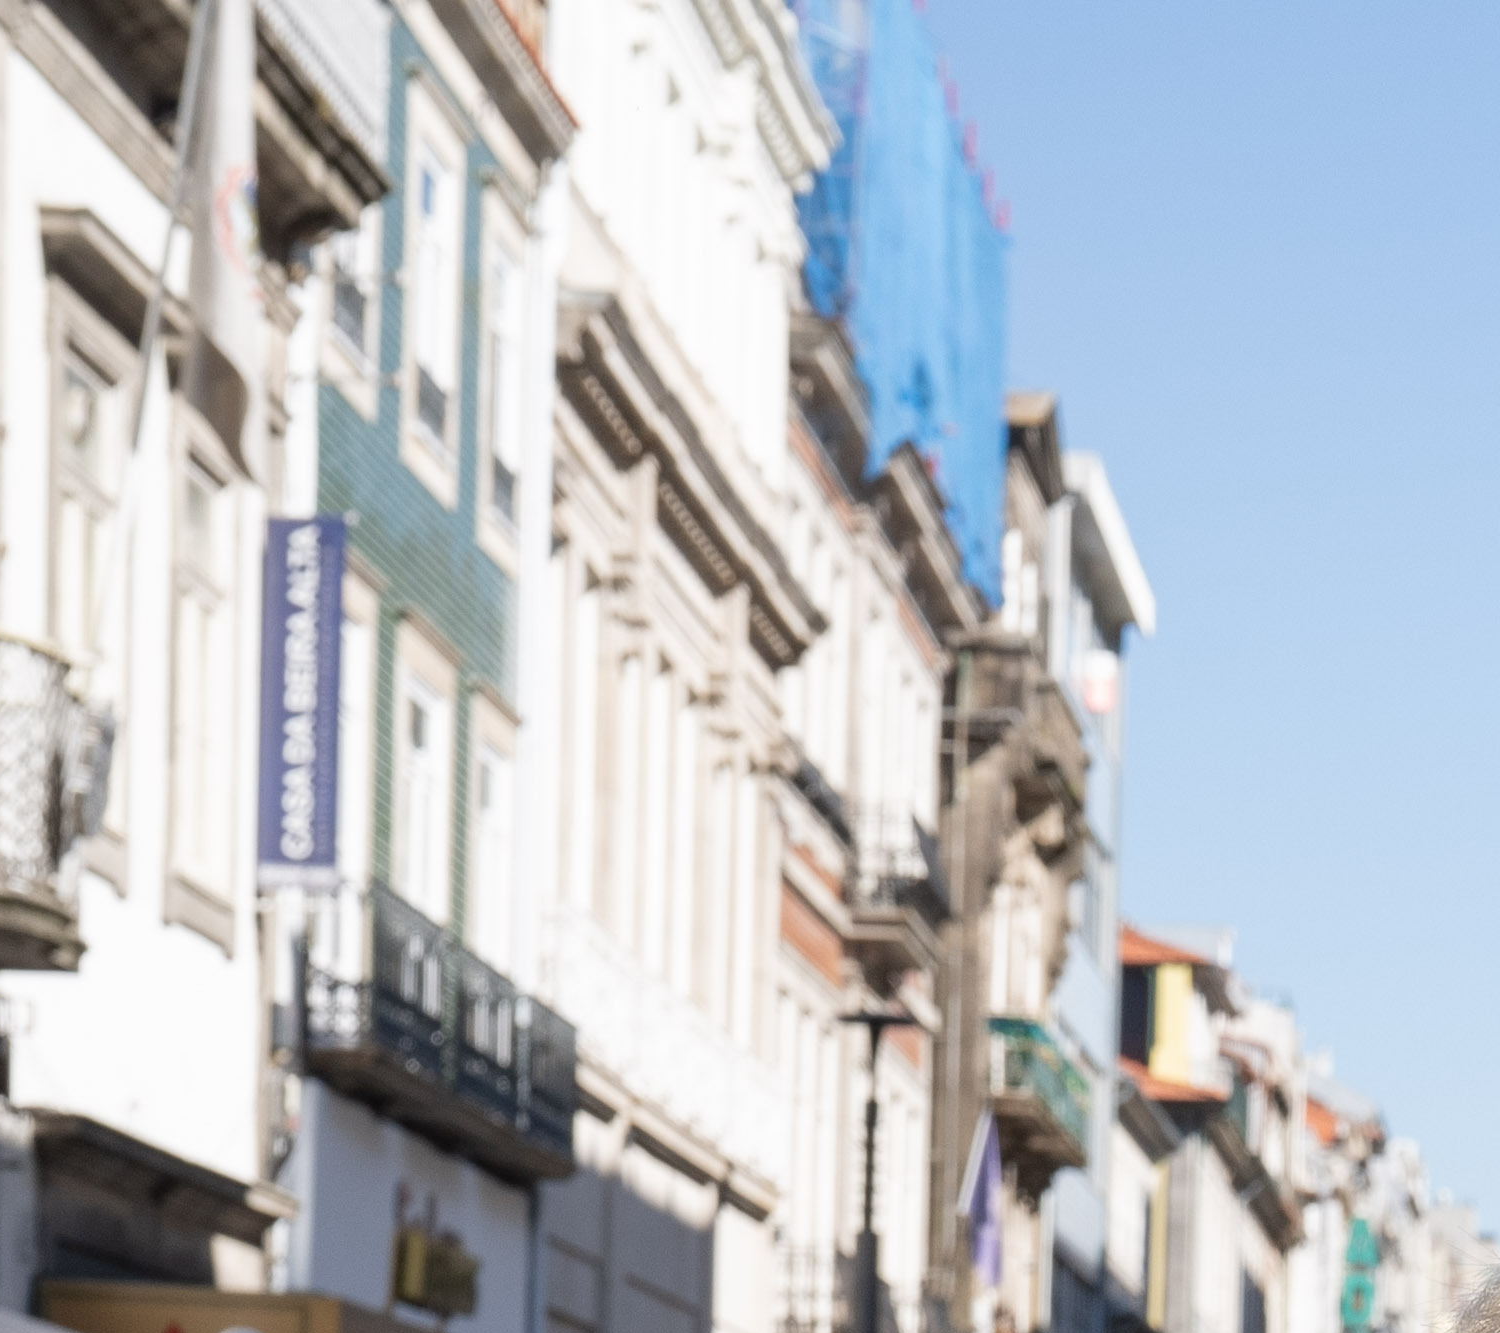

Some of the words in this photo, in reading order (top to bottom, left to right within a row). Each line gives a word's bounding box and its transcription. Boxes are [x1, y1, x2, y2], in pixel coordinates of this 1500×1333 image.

[286, 524, 321, 609] ALTA
[283, 611, 318, 713] BEIRA
[282, 715, 316, 765] DA
[280, 766, 316, 861] CASA
